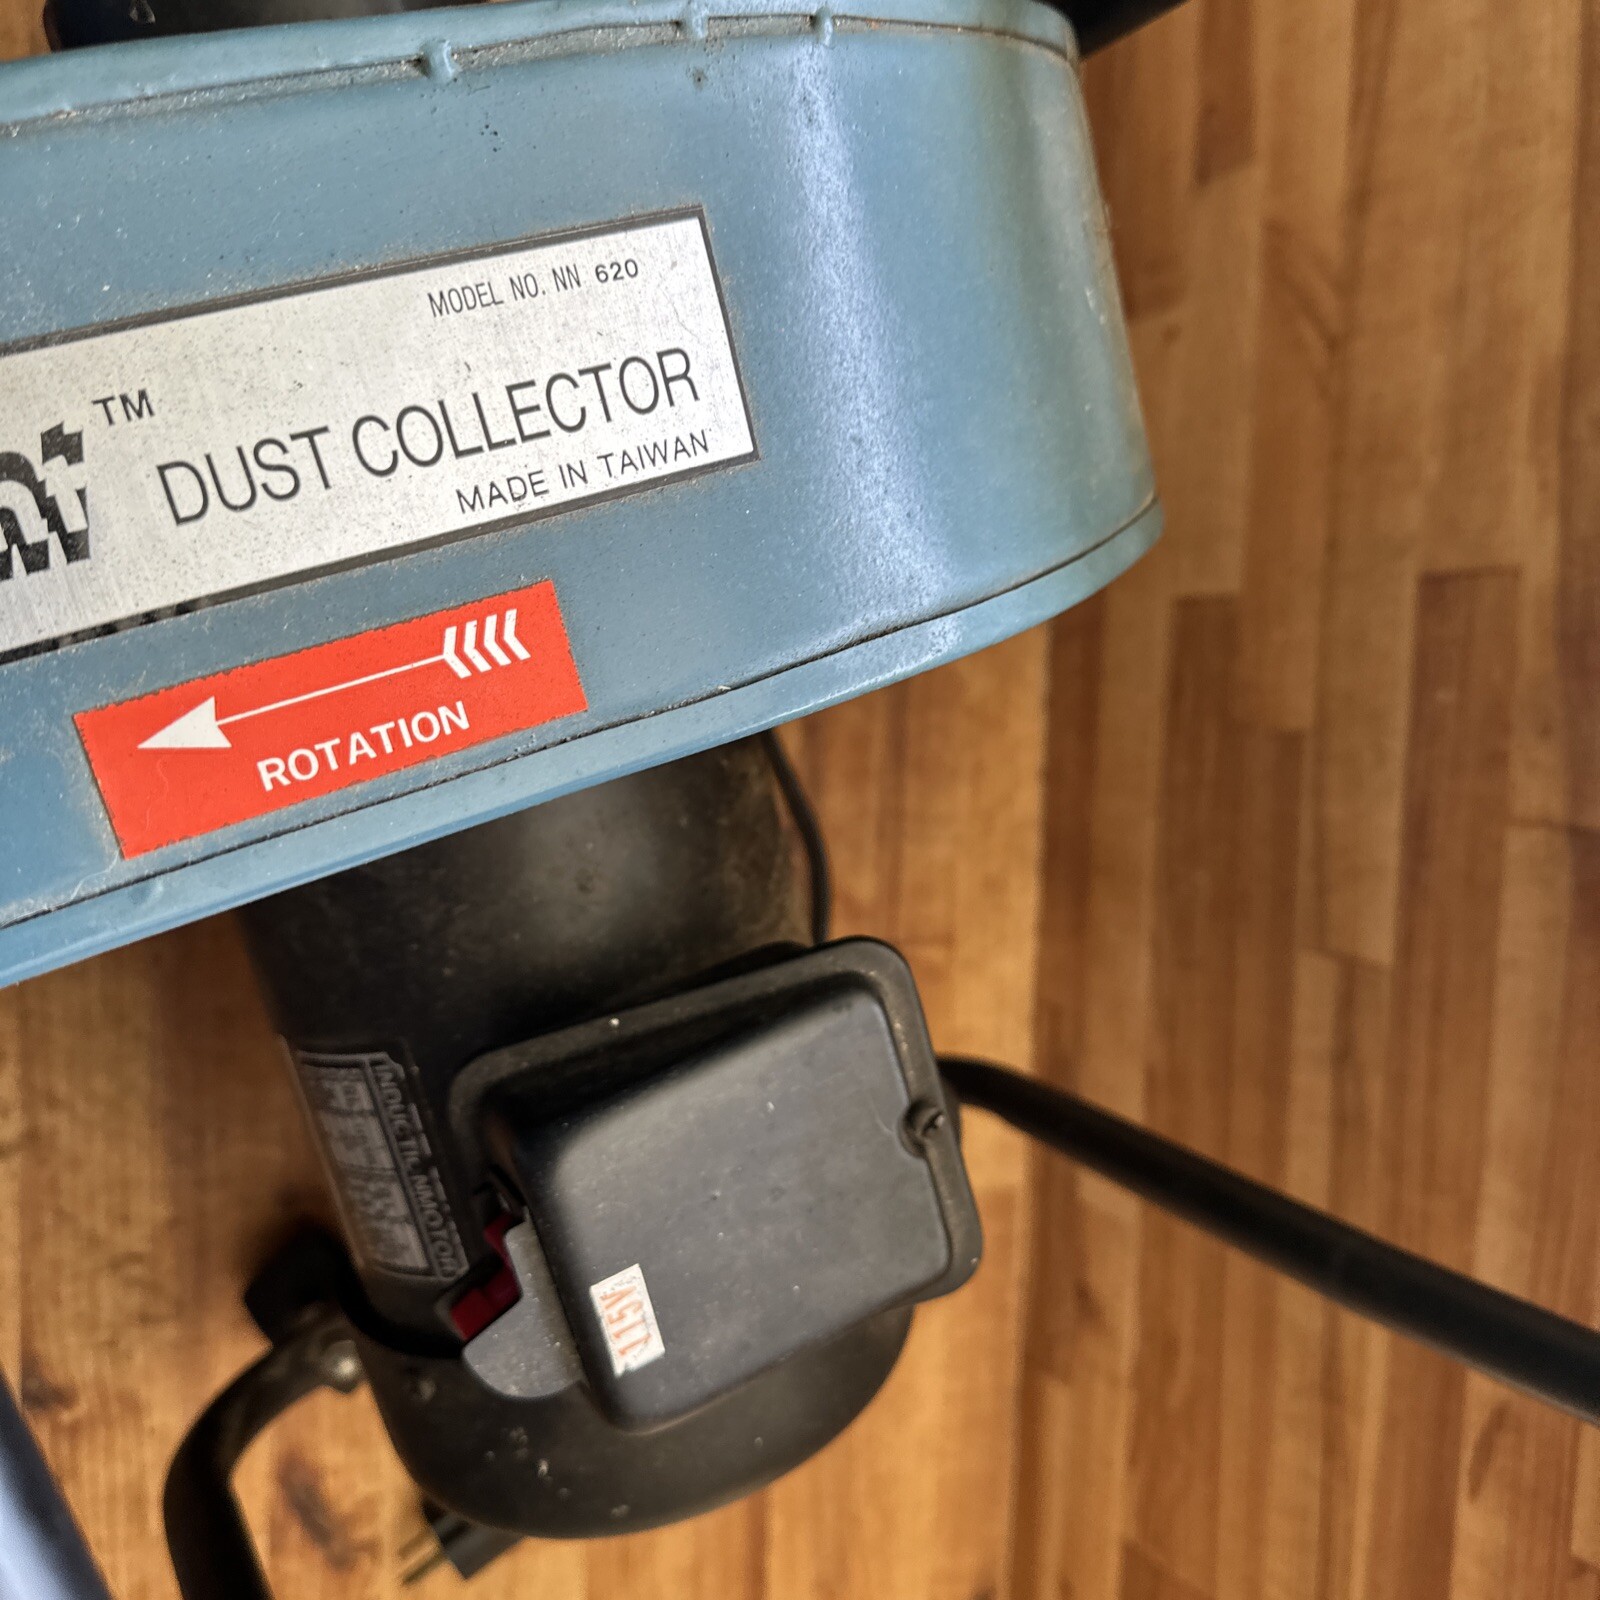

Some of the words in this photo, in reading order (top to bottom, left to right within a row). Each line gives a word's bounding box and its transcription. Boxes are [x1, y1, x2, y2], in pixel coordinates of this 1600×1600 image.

[427, 282, 504, 318] MODEL
[509, 273, 547, 302] NO.
[552, 263, 582, 294] NN
[594, 258, 640, 284] 620
[156, 426, 331, 527] DUST
[352, 347, 700, 478] COLLECTOR
[456, 469, 550, 514] MADE
[558, 459, 589, 489] IN
[597, 429, 709, 479] TAIWAN
[256, 700, 471, 791] ROTATION
[599, 1284, 653, 1357] 115V
